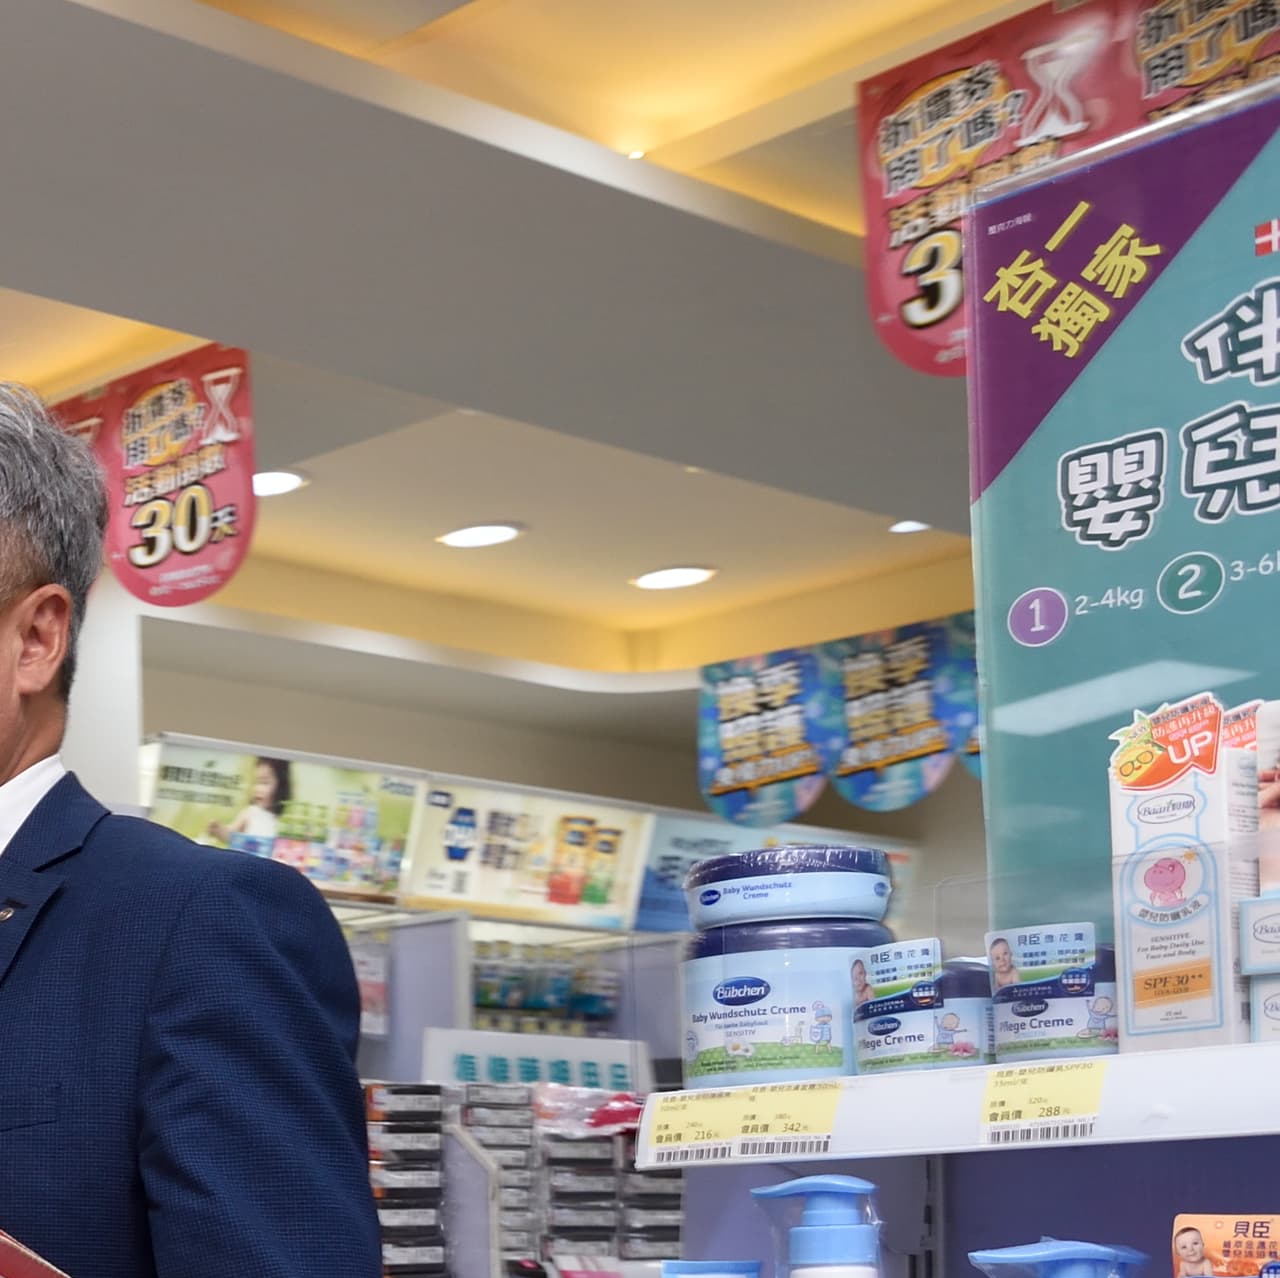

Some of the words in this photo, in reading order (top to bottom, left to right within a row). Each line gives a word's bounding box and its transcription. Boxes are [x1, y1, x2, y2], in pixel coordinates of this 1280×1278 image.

[983, 200, 1091, 318] 杏一
[900, 228, 966, 331] 3
[1031, 223, 1166, 358] 獨家
[1029, 599, 1045, 632] 1
[1074, 585, 1146, 616] 2-4kg
[1177, 564, 1204, 600] 2
[1167, 730, 1214, 765] UP
[723, 886, 740, 897] Baby
[742, 881, 792, 893] Wundschutz
[743, 890, 769, 900] Creme
[1017, 933, 1041, 947] 貝臣
[870, 949, 891, 964] 貝臣
[1143, 975, 1172, 991] SPF
[715, 982, 770, 1001] Bübchen
[709, 1006, 768, 1021] Wundschutz
[1029, 1016, 1075, 1030] Creme
[883, 1031, 925, 1045] Creme
[989, 1109, 1023, 1122] 會員價
[655, 1132, 683, 1144] 會員價
[1233, 1221, 1271, 1239] 貝臣
